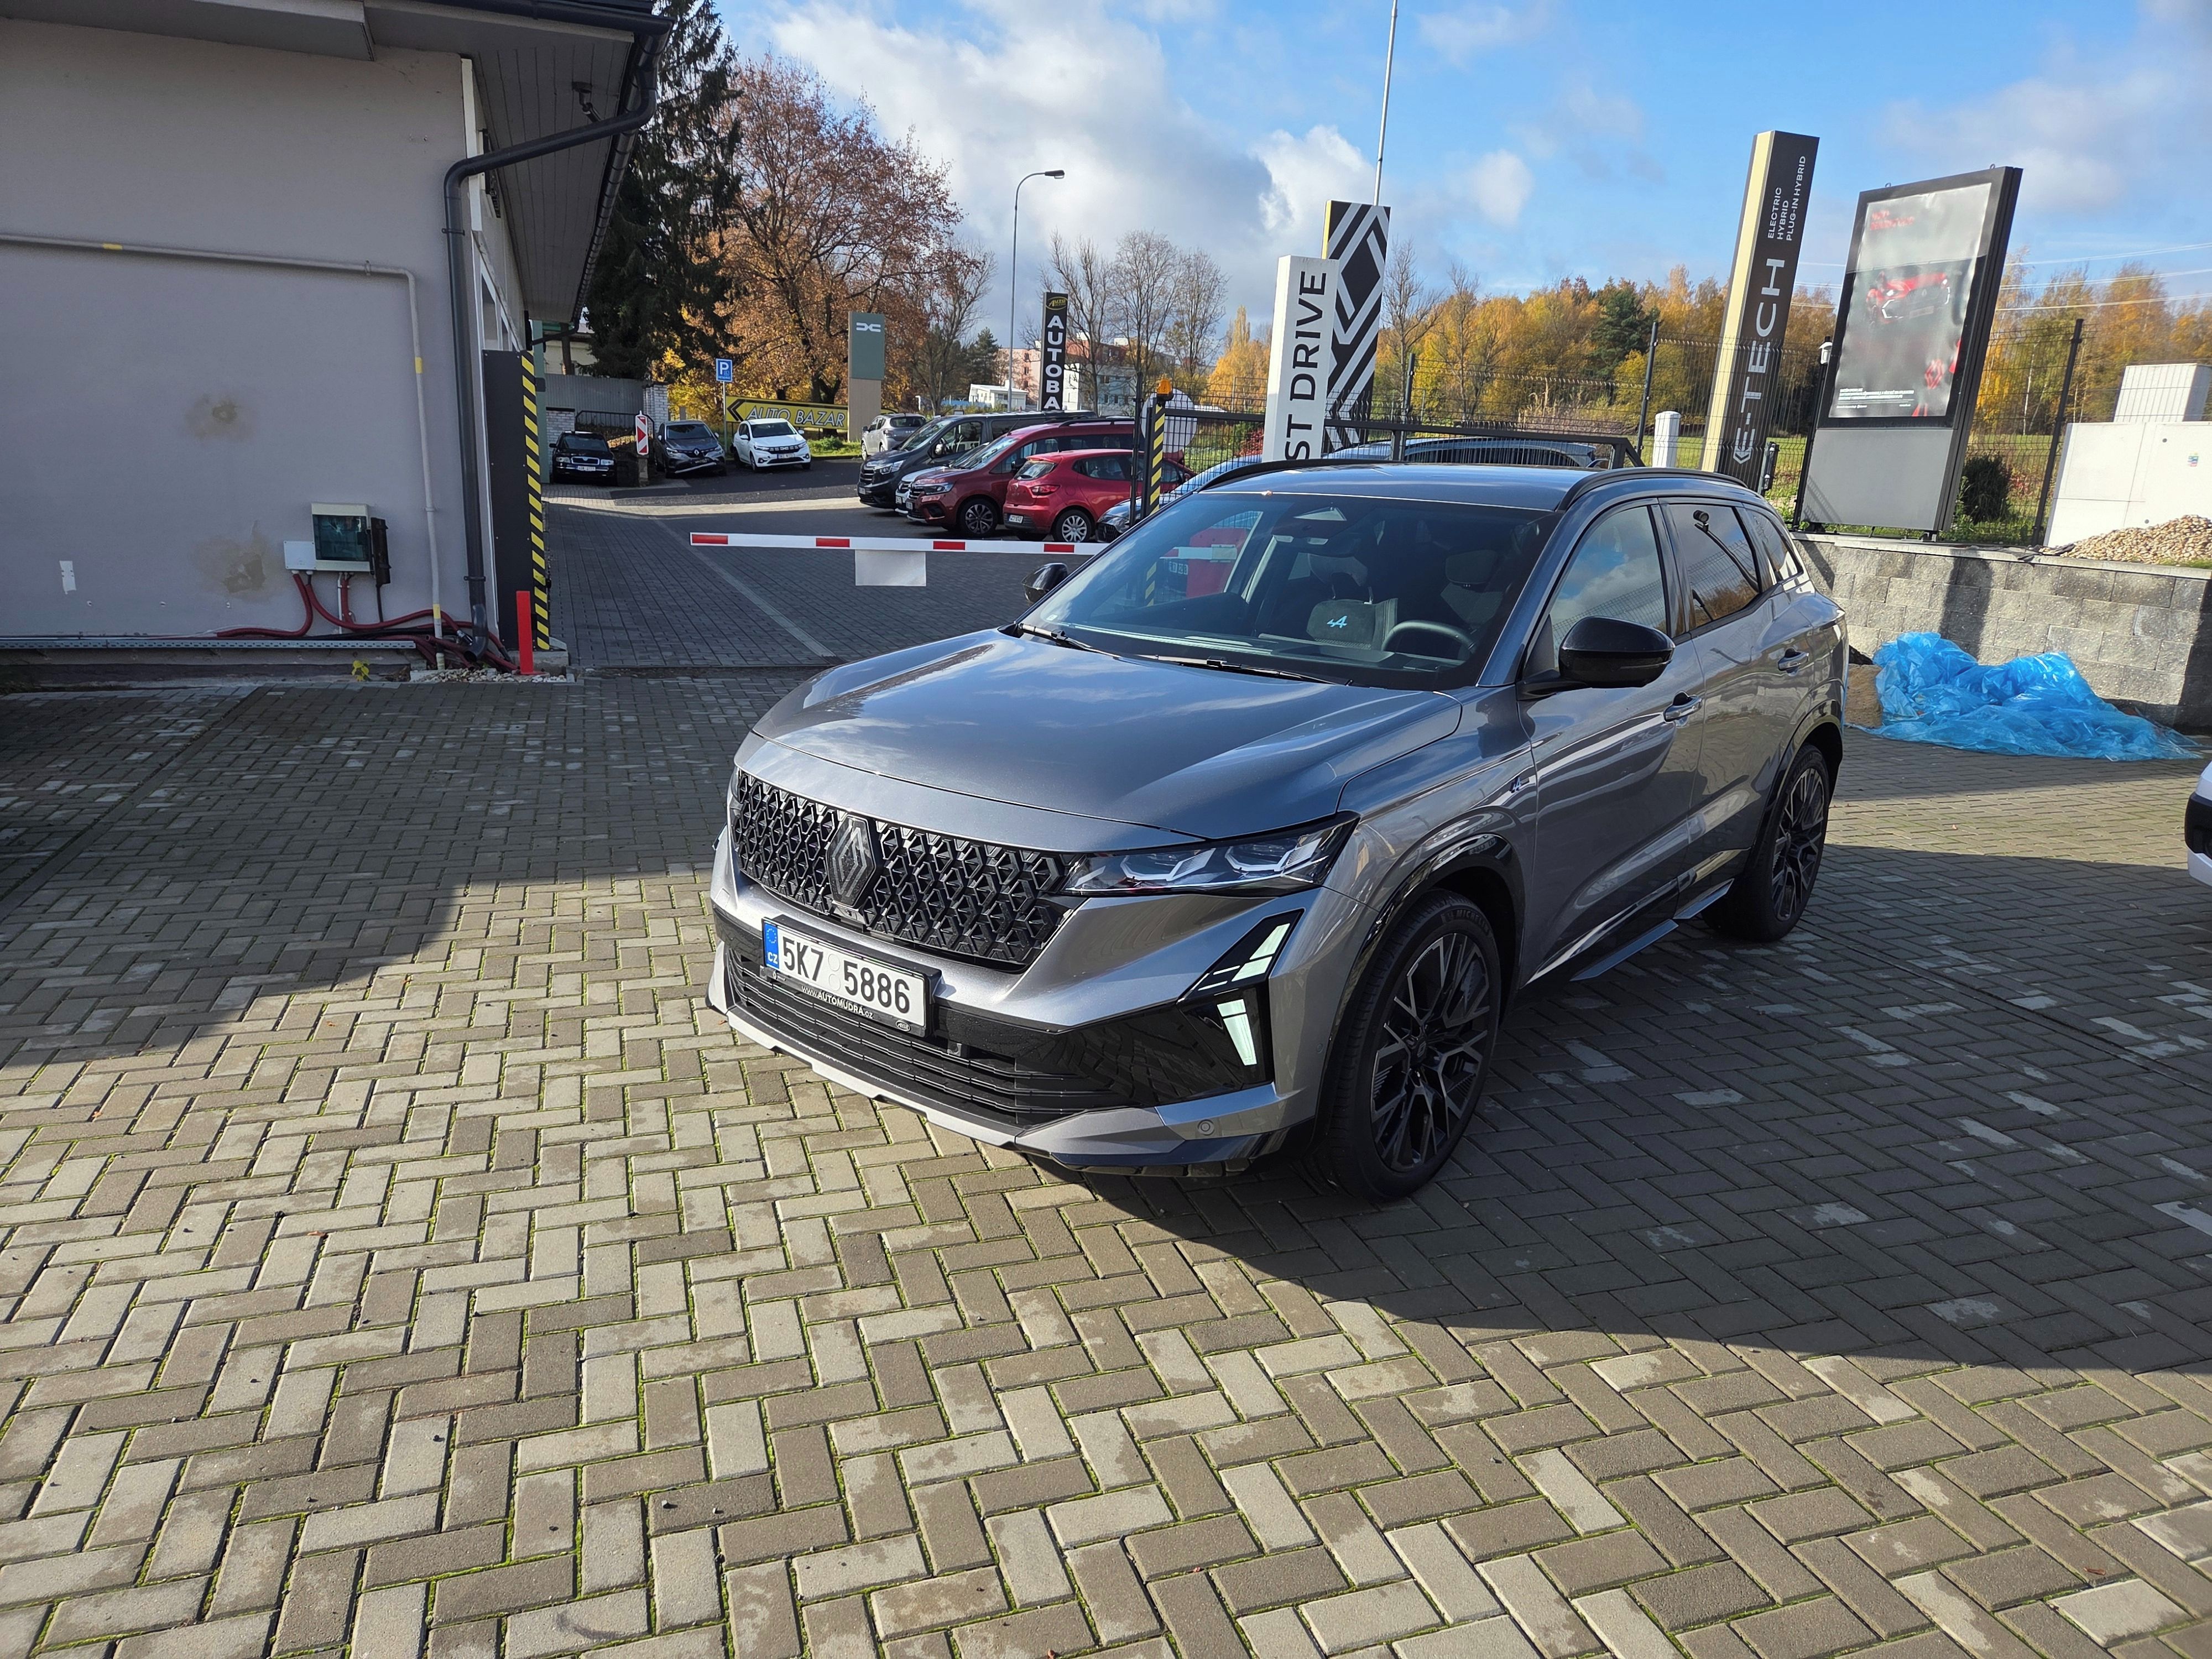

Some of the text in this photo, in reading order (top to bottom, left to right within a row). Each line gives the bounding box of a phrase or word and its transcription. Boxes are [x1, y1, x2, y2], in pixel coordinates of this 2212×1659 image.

[1767, 187, 1782, 238] ELECTRIC
[1777, 200, 1789, 240] HYBRID
[1786, 155, 1806, 241] PLUG-IN HYBRID
[1290, 271, 1327, 401] DRIVE
[719, 362, 729, 375] P
[747, 405, 846, 427] AUTO BAZAR
[768, 952, 779, 964] CZ
[782, 936, 910, 1014] 5K7 5886
